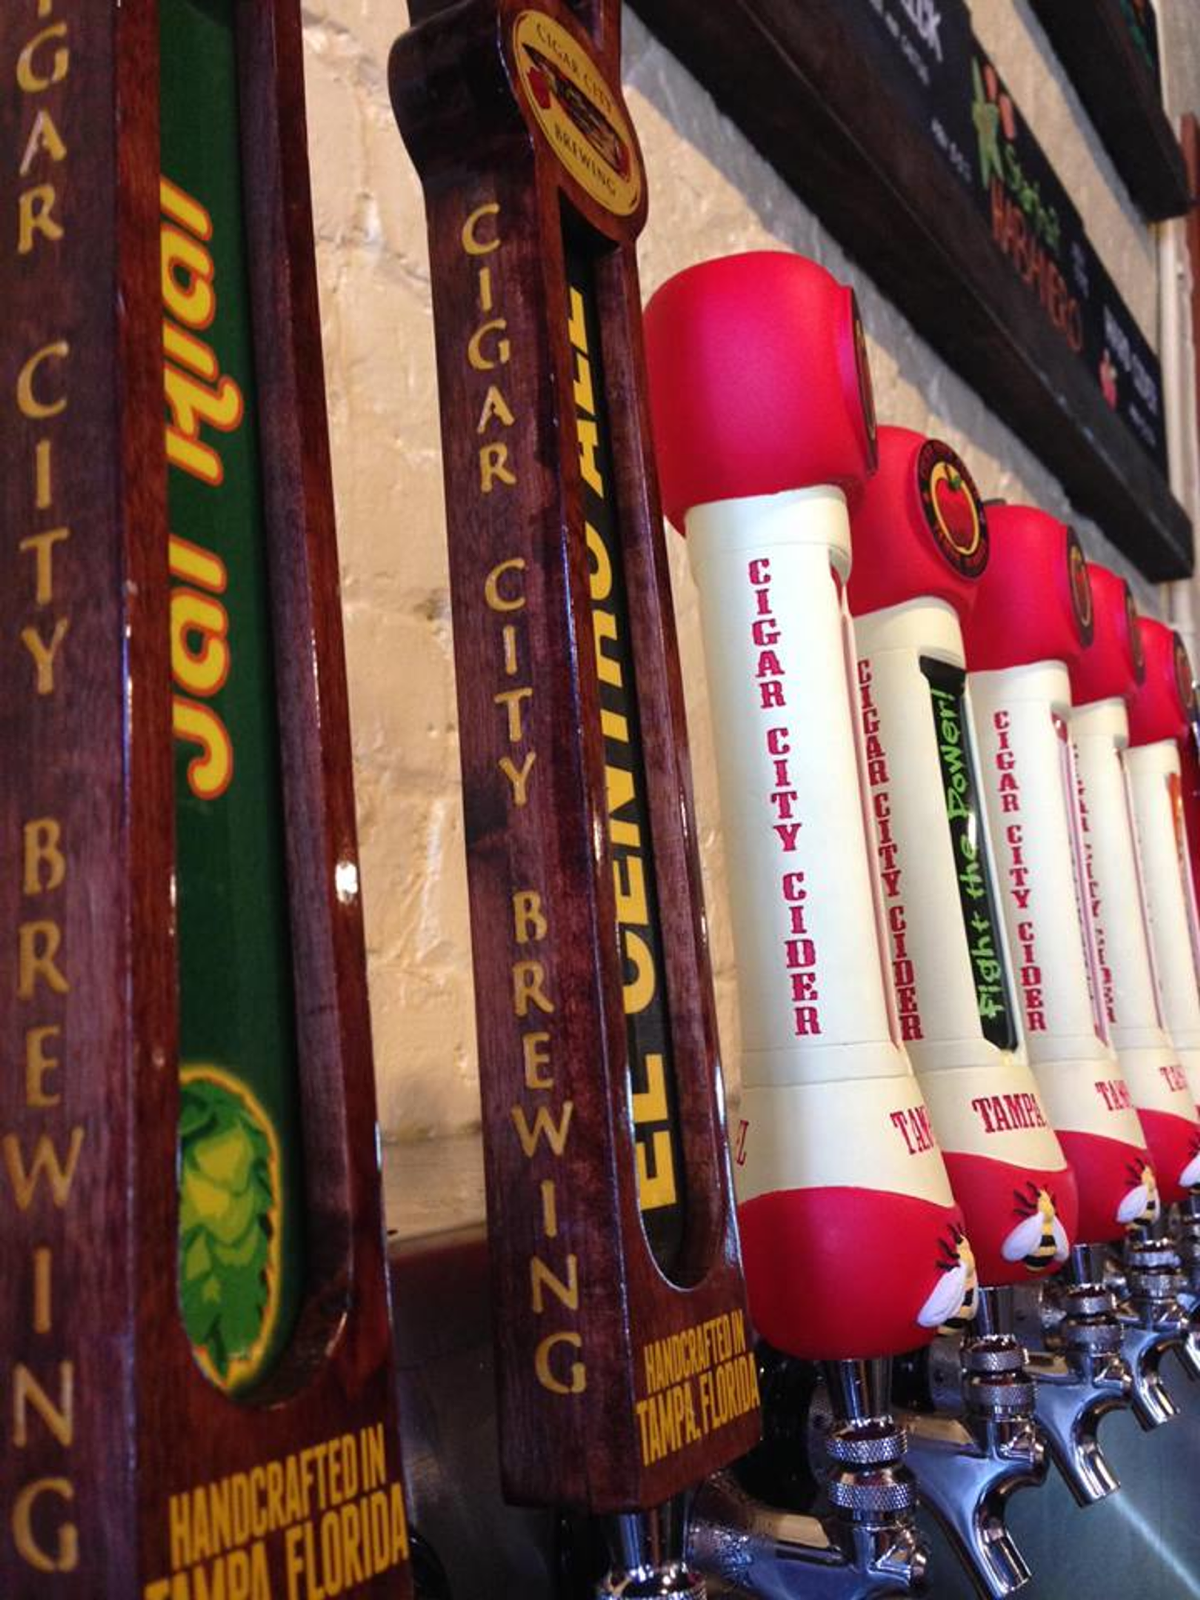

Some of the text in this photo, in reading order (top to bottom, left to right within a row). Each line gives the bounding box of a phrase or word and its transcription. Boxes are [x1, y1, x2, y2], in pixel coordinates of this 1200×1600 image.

[536, 23, 613, 114] CIGAR CITY
[554, 121, 618, 198] BREWING
[3, 0, 84, 1572] GAR CITY BREWING
[461, 203, 587, 1395] CIGAR CITY BREWING
[748, 557, 823, 1037] CIGAR CITY CIDER
[857, 658, 924, 1041] CIGAR CITY CIDER
[993, 709, 1047, 1032] CIGAR CITY CIDER
[633, 1053, 677, 1212] EL
[972, 1092, 1047, 1134] TAMPA
[644, 1308, 747, 1396] HANDCRAFTED IN
[699, 1351, 761, 1435] FLORIDA
[143, 1481, 410, 1600] MPA FLORIDA
[169, 1422, 386, 1570] HANDCRAFTED IN
